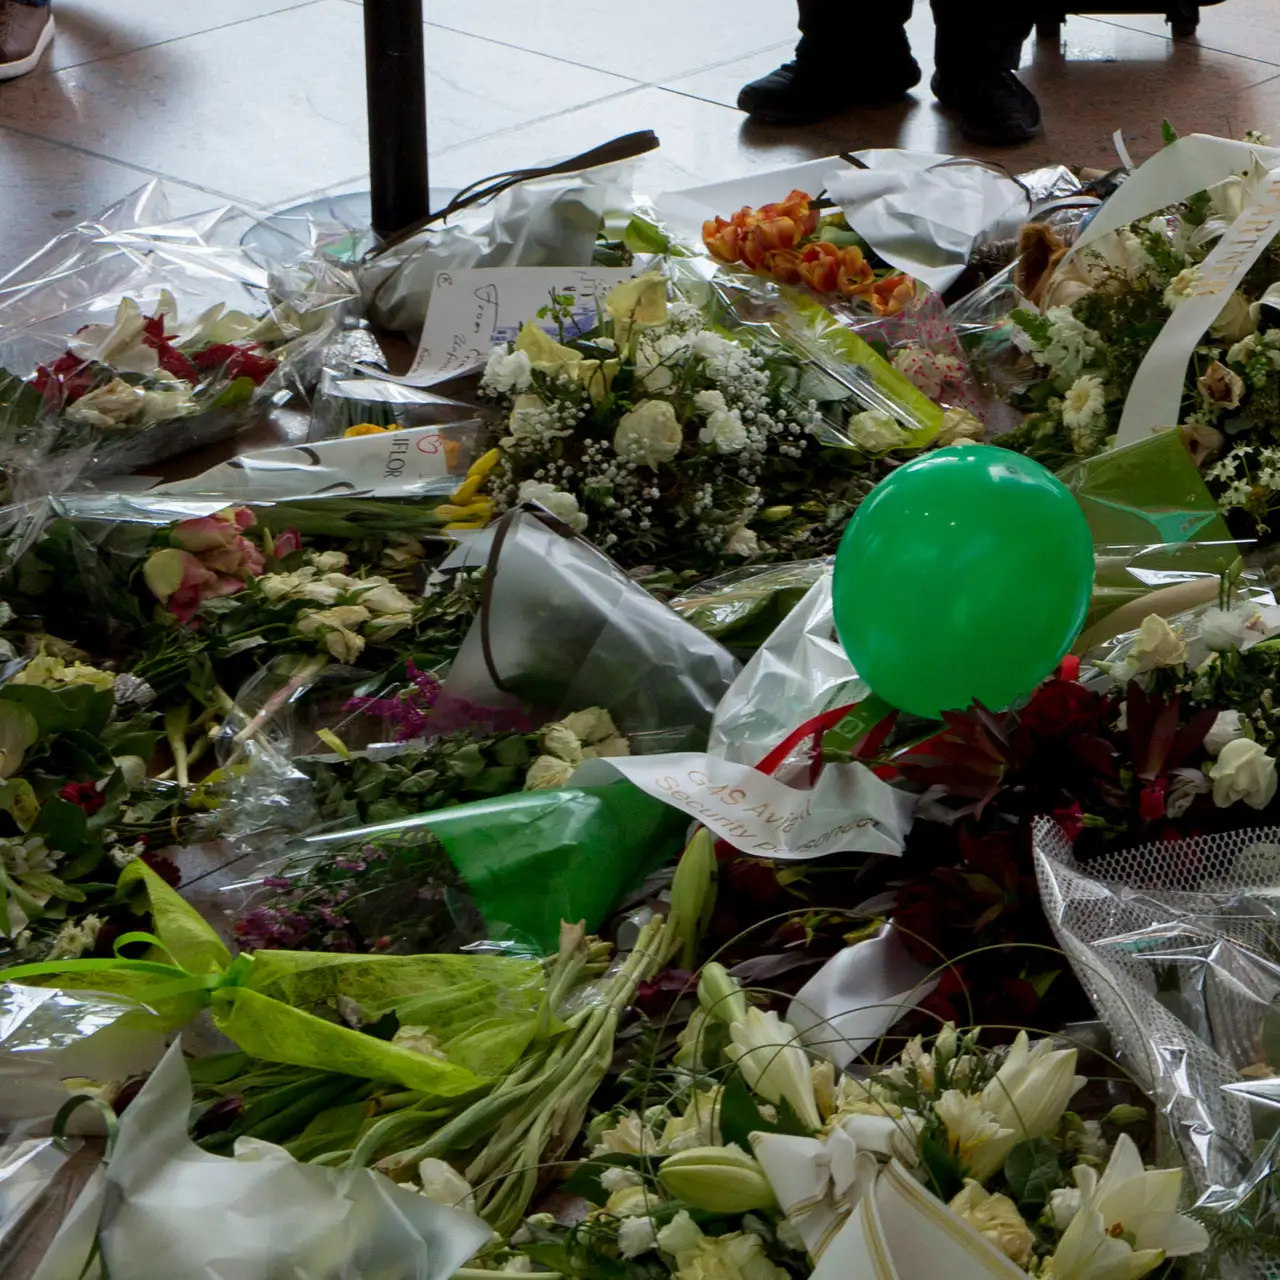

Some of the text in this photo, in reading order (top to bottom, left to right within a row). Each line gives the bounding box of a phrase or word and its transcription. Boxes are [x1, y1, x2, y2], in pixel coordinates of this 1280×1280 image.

[383, 434, 410, 479] IFLOR
[655, 775, 757, 840] Security
[687, 770, 748, 807] G4S
